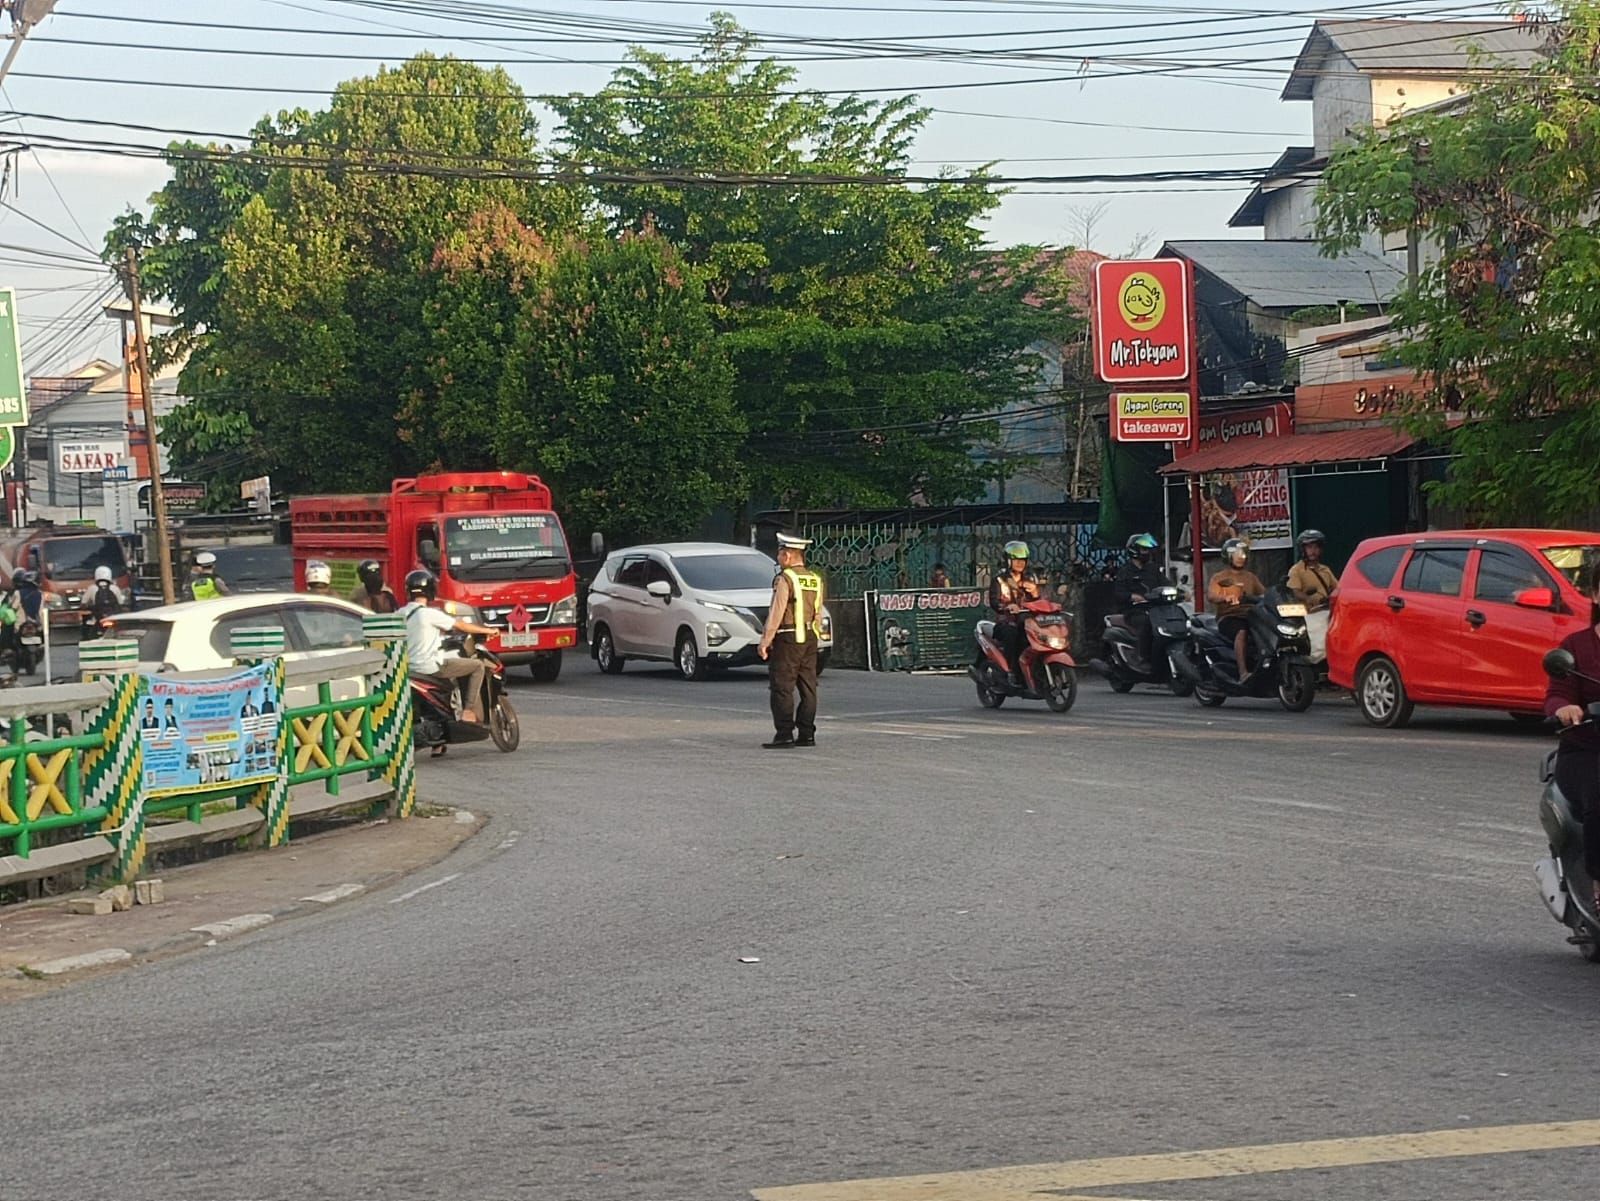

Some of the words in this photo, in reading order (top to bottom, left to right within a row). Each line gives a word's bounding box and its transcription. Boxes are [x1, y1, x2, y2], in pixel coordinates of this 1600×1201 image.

[1123, 398, 1150, 414] Ayam
[1151, 398, 1185, 414] Goreng
[1123, 421, 1185, 435] takeaway
[1220, 418, 1264, 442] Goreng
[880, 594, 915, 611] NASI
[918, 592, 981, 609] GORENG
